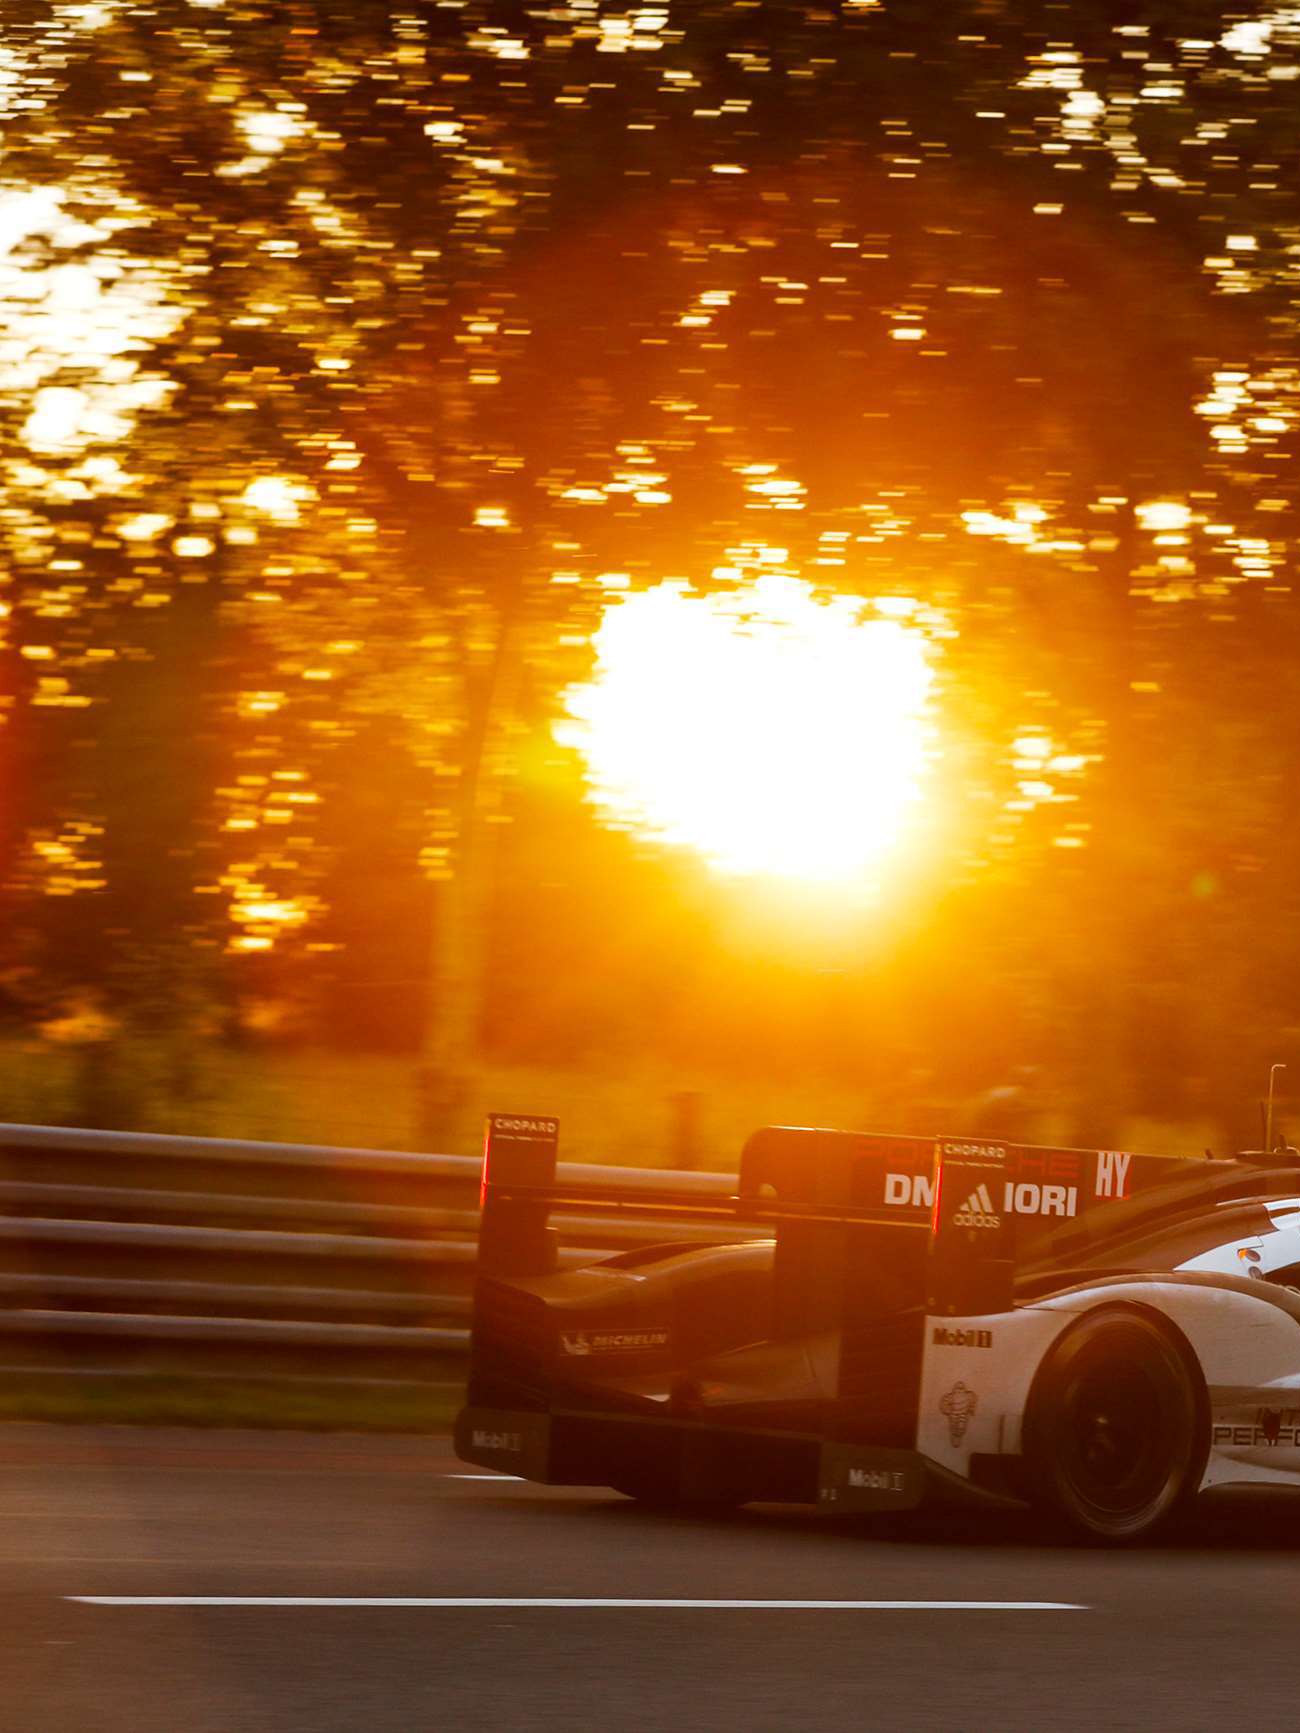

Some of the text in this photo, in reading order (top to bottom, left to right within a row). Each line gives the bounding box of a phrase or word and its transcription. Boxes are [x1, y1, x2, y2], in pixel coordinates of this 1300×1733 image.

[494, 1117, 557, 1133] CHOPARD
[943, 1143, 1006, 1159] CHOPARD
[1095, 1151, 1131, 1198] HY
[884, 1172, 935, 1207] DM
[953, 1212, 1001, 1229] adidas
[592, 1333, 666, 1346] MICHELIN
[932, 1328, 976, 1347] Mobil
[471, 1429, 508, 1449] Mobil
[848, 1467, 888, 1489] Mobil
